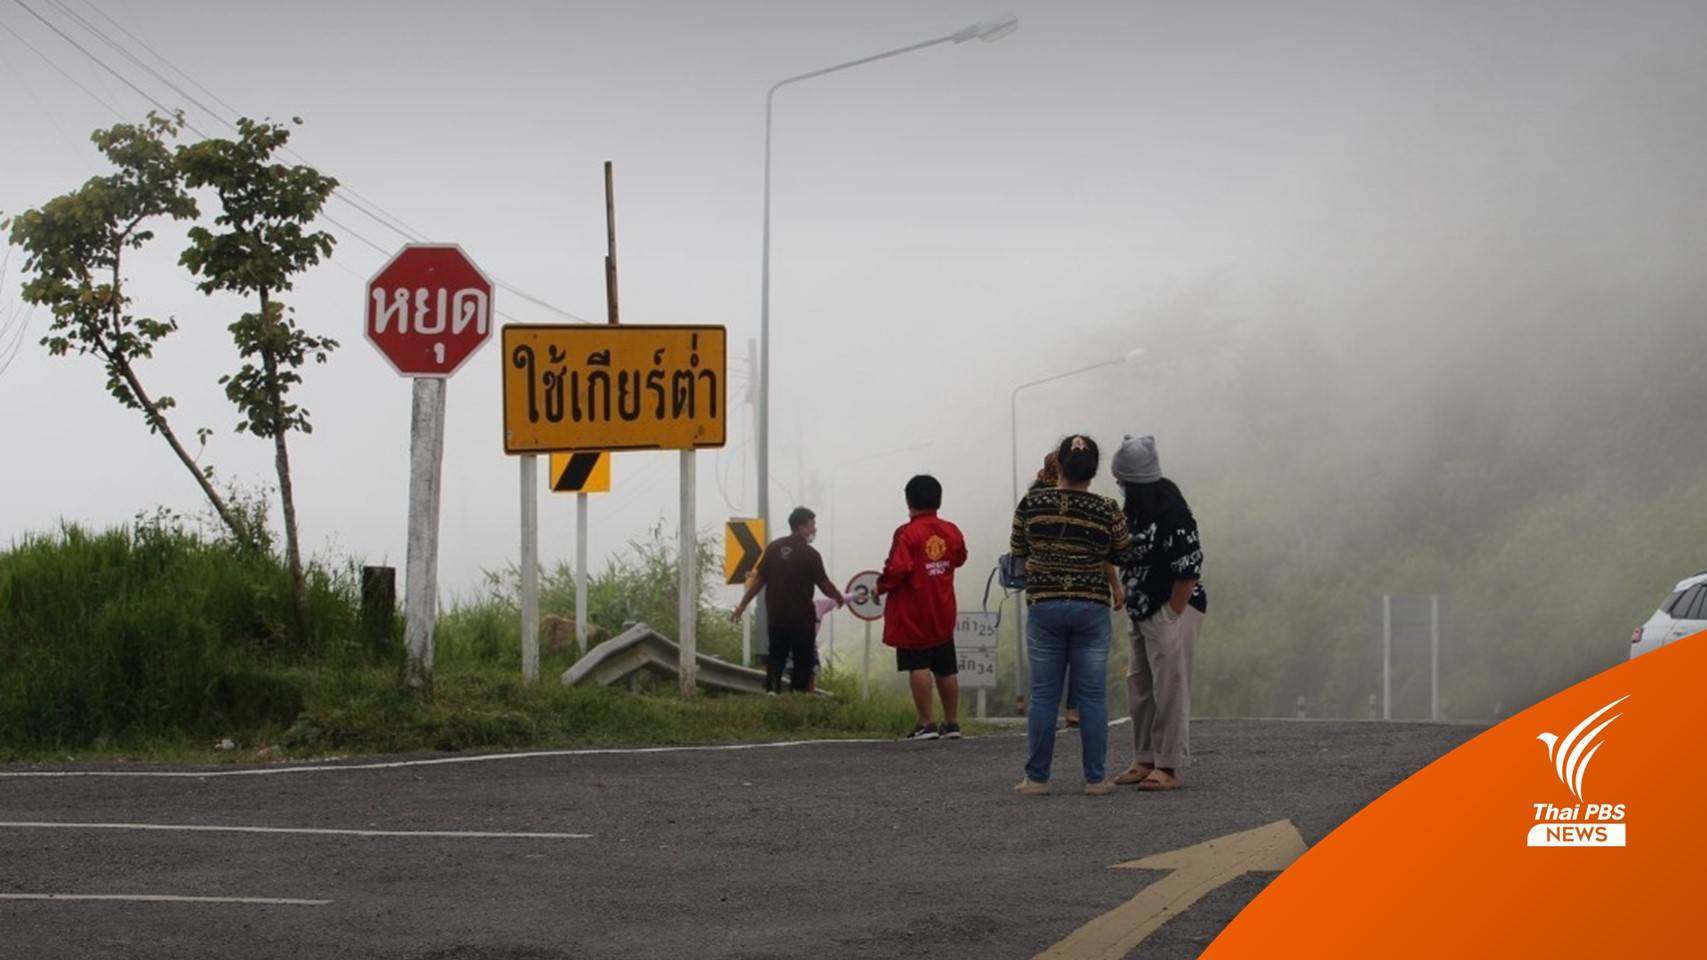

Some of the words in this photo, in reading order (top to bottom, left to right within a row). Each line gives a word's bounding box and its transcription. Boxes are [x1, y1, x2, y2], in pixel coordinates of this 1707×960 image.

[373, 286, 488, 365] หยุด
[512, 333, 717, 424] ใช้เกียร์ต่ำ
